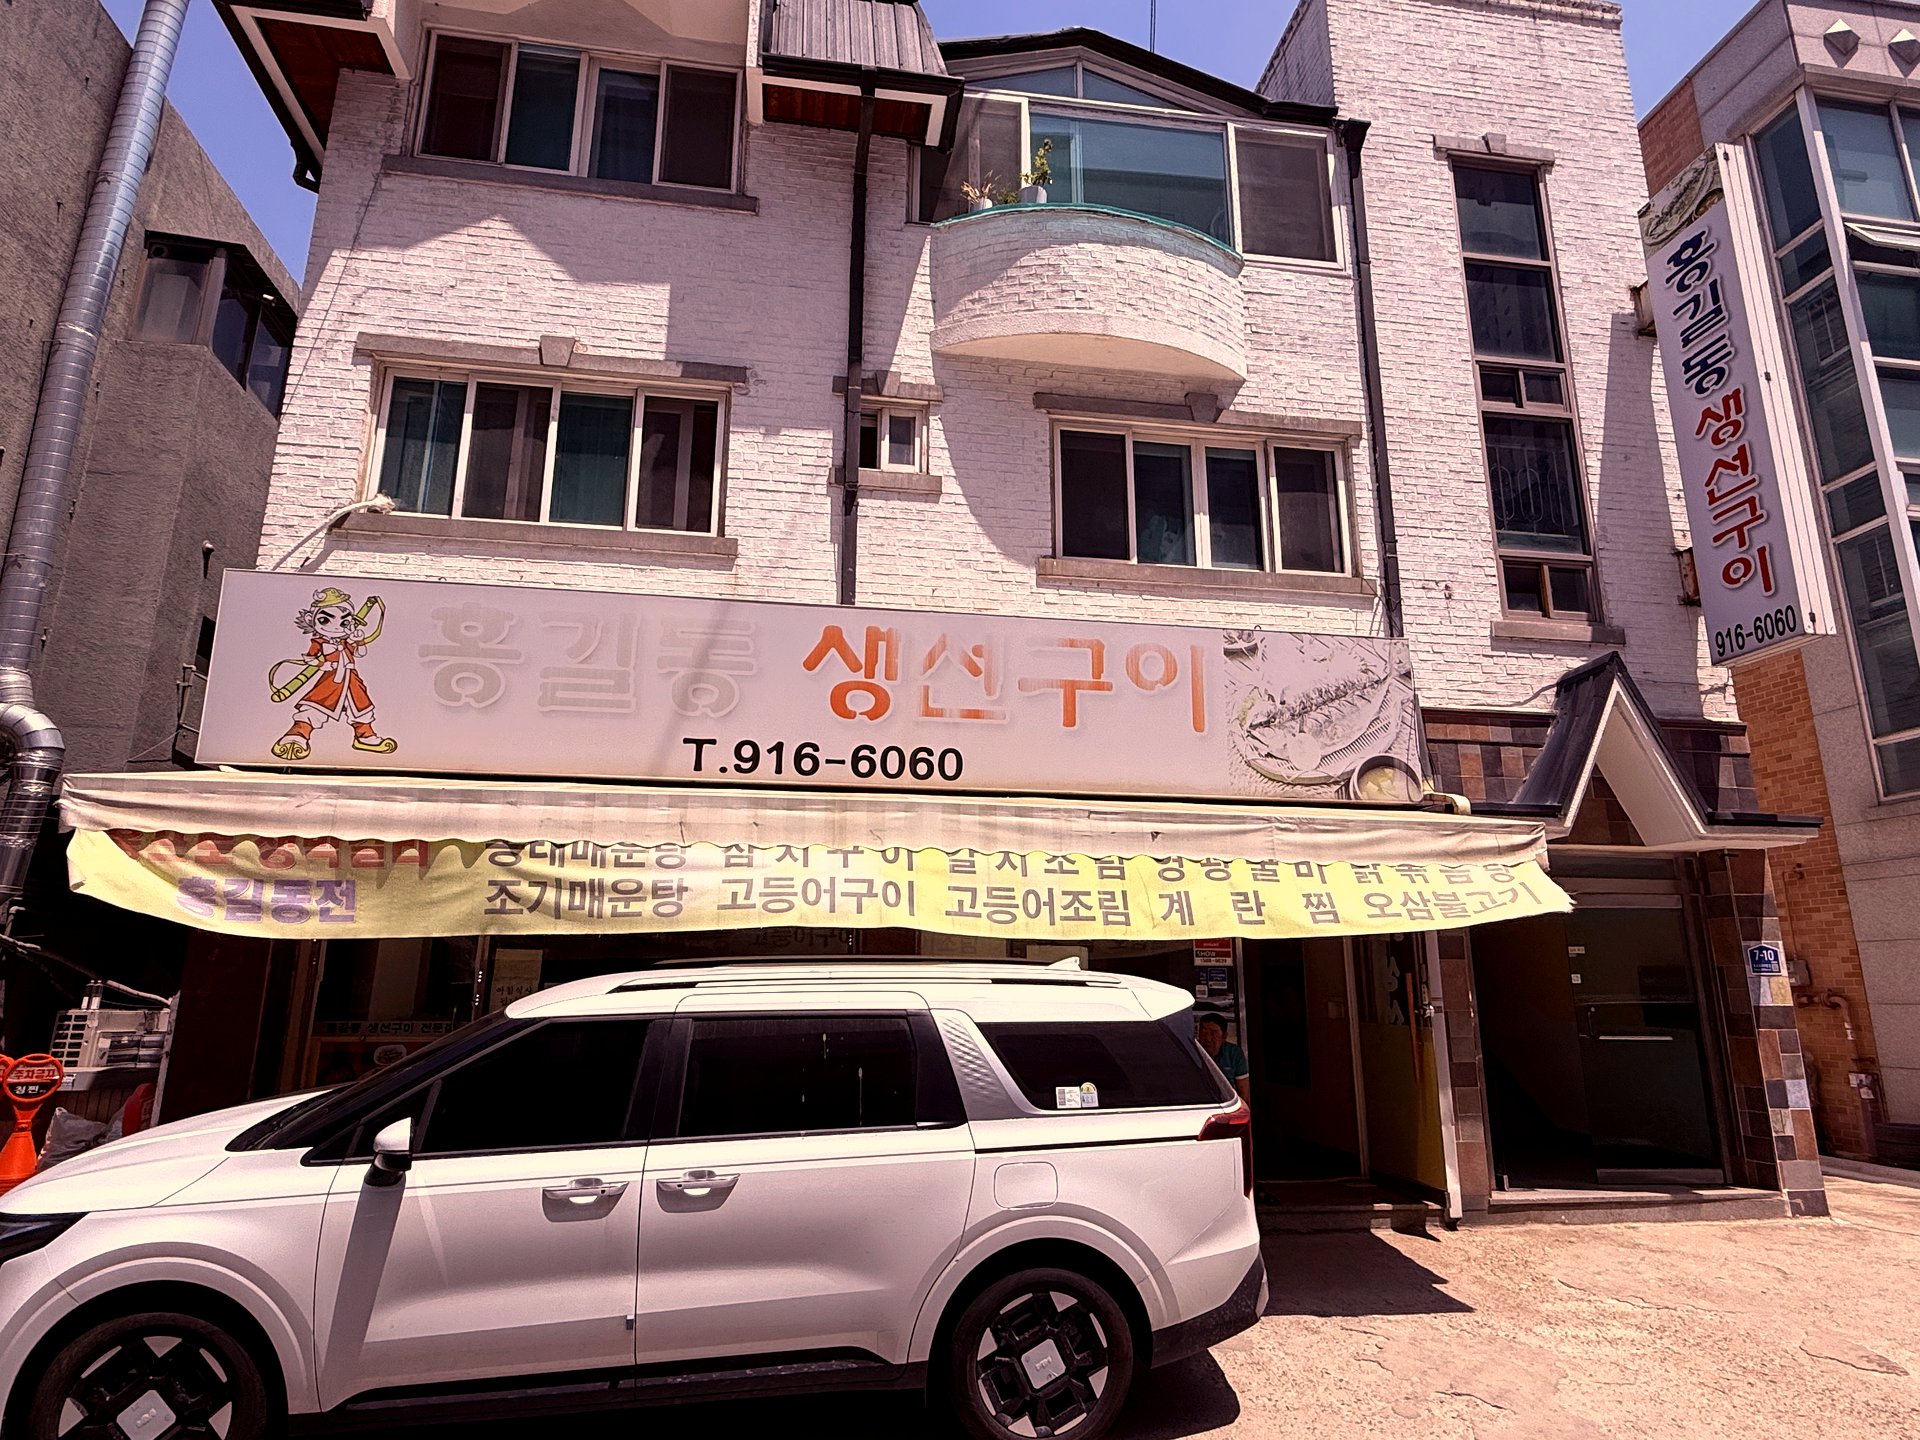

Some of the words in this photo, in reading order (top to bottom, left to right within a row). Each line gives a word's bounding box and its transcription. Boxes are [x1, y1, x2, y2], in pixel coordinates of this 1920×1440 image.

[1663, 226, 1737, 397] 홍길동
[1695, 386, 1775, 596] 생선구이
[1714, 605, 1798, 658] 916-6060
[418, 603, 758, 718] 홍길동
[802, 623, 1209, 735] 생선구이
[682, 737, 964, 782] T.916-6060
[176, 876, 357, 925] 홍길동전
[484, 877, 689, 919] 조기매운탕
[717, 876, 916, 917] 고등어구이
[945, 885, 1132, 927] 고등어조림
[1363, 881, 1543, 921] 오삼불고기
[1753, 949, 1775, 961] 7-10
[368, 1022, 415, 1034] 생선구이
[14, 1068, 55, 1080] 주차금지
